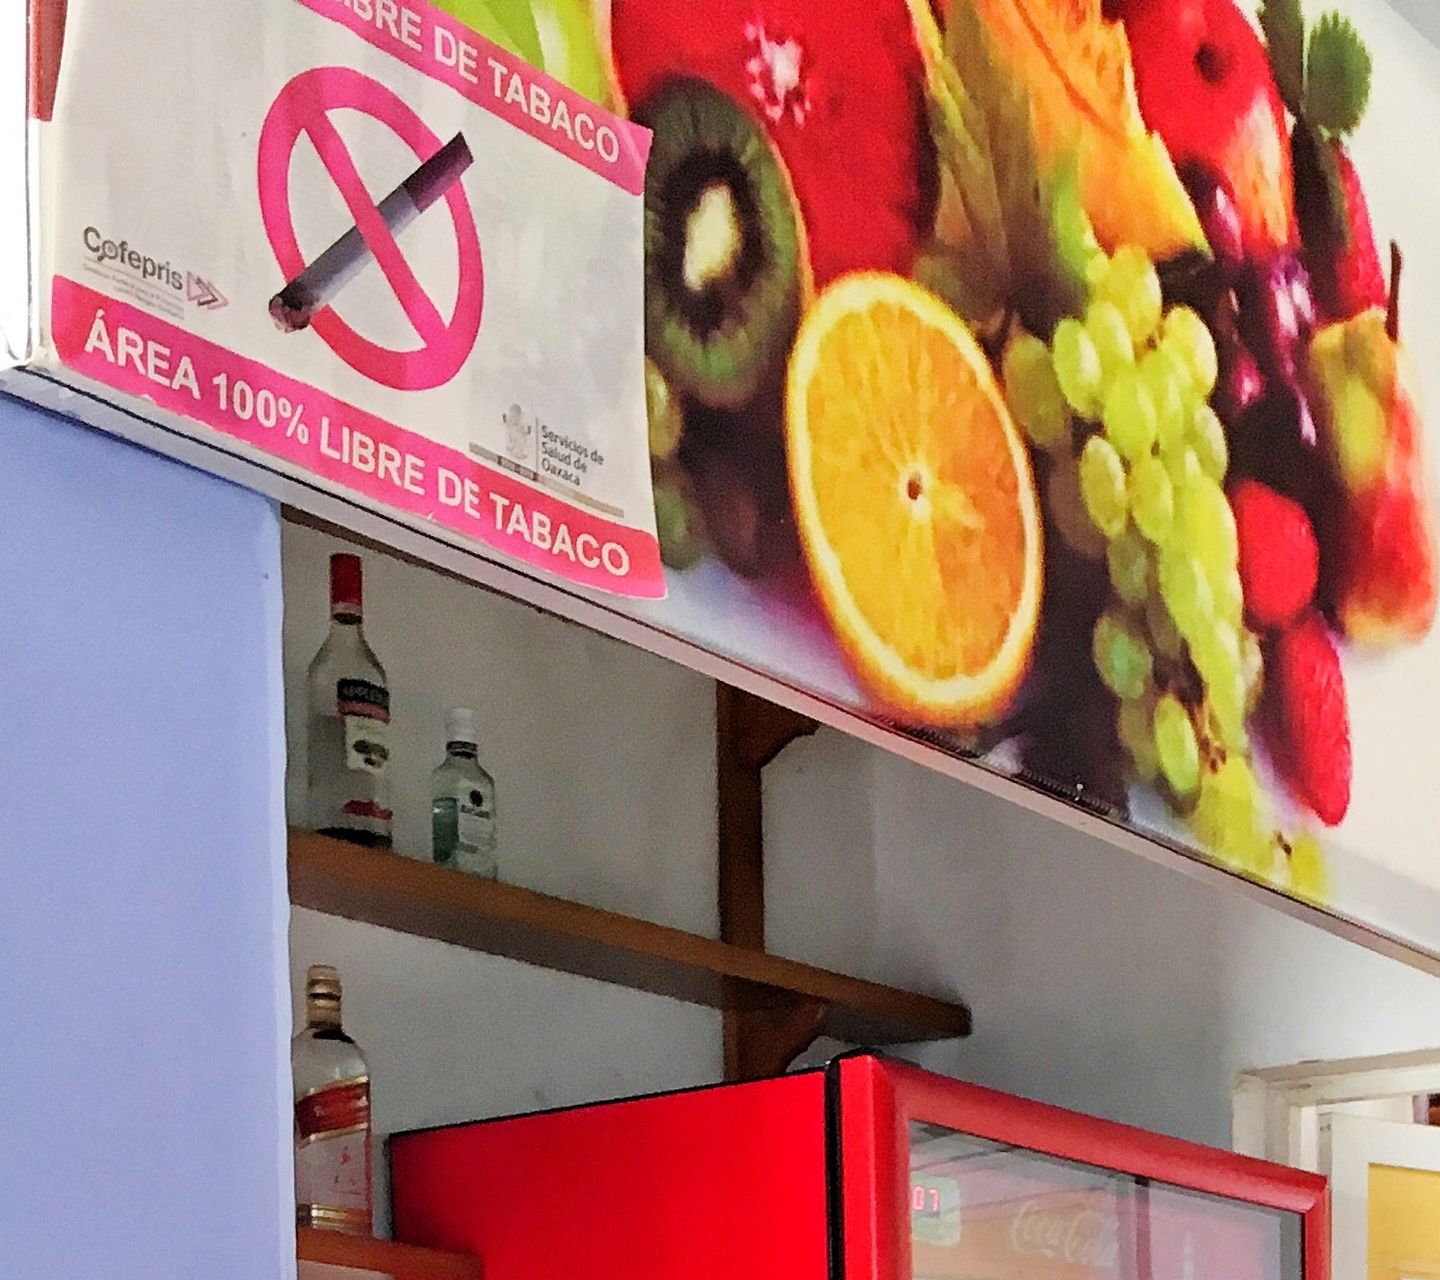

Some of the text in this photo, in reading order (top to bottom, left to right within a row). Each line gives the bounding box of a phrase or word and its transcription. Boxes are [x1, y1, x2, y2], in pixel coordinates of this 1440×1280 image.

[336, 0, 620, 163] BRE DE TABACO
[83, 226, 183, 290] Cofepris
[84, 309, 630, 577] ÁREA 100% LIBRE DE TABACO
[541, 424, 605, 467] Servicios de
[541, 441, 588, 473] Salud de
[541, 457, 581, 486] Oaxaca
